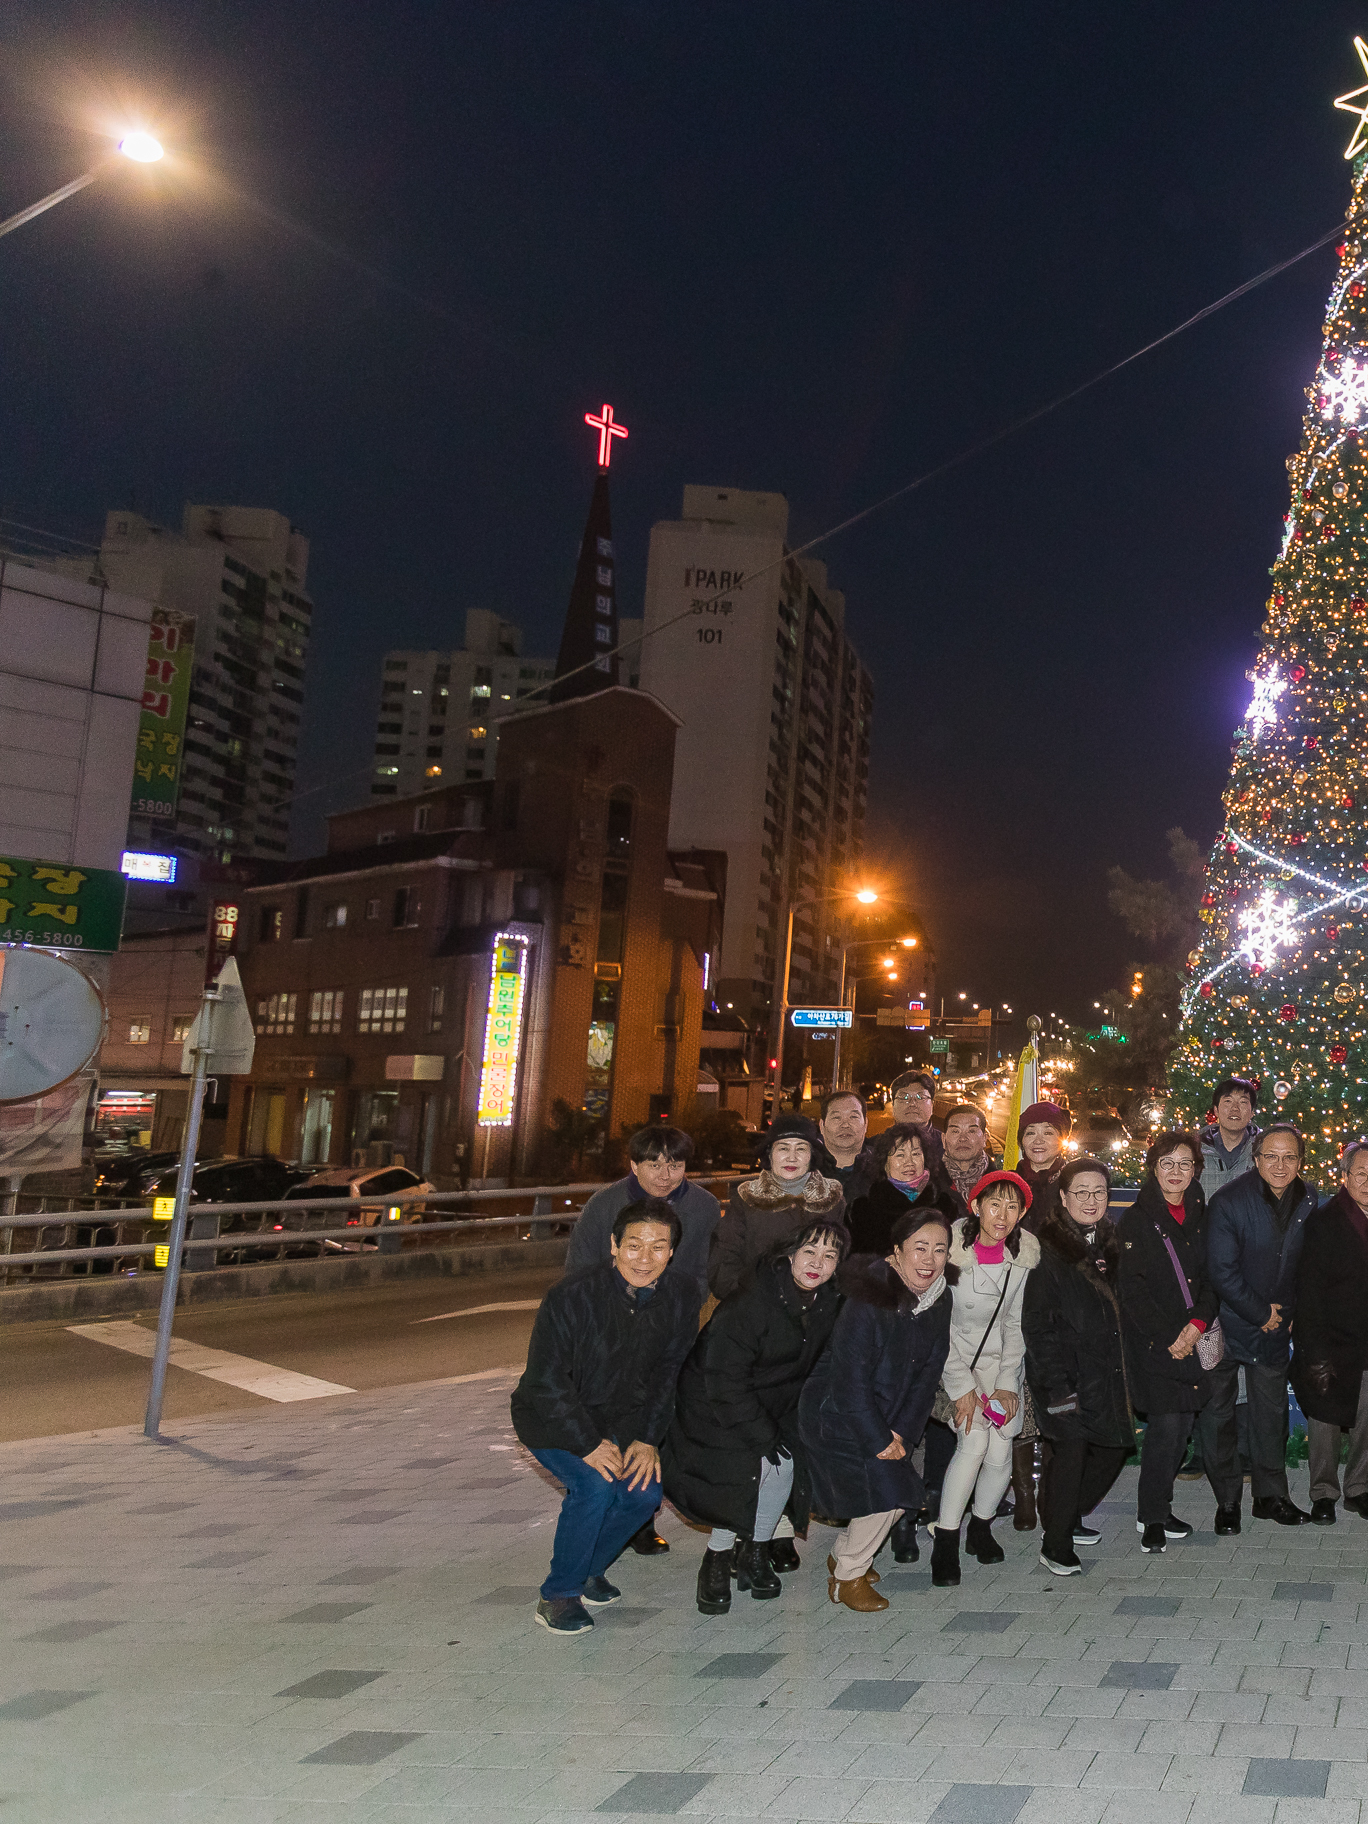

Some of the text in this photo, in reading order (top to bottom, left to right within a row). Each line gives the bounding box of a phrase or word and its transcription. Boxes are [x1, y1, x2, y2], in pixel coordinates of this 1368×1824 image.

[690, 599, 734, 615] 광나루
[696, 627, 723, 644] 101
[494, 974, 517, 1047] 남원추어탕
[487, 1051, 508, 1115] 민물장어
